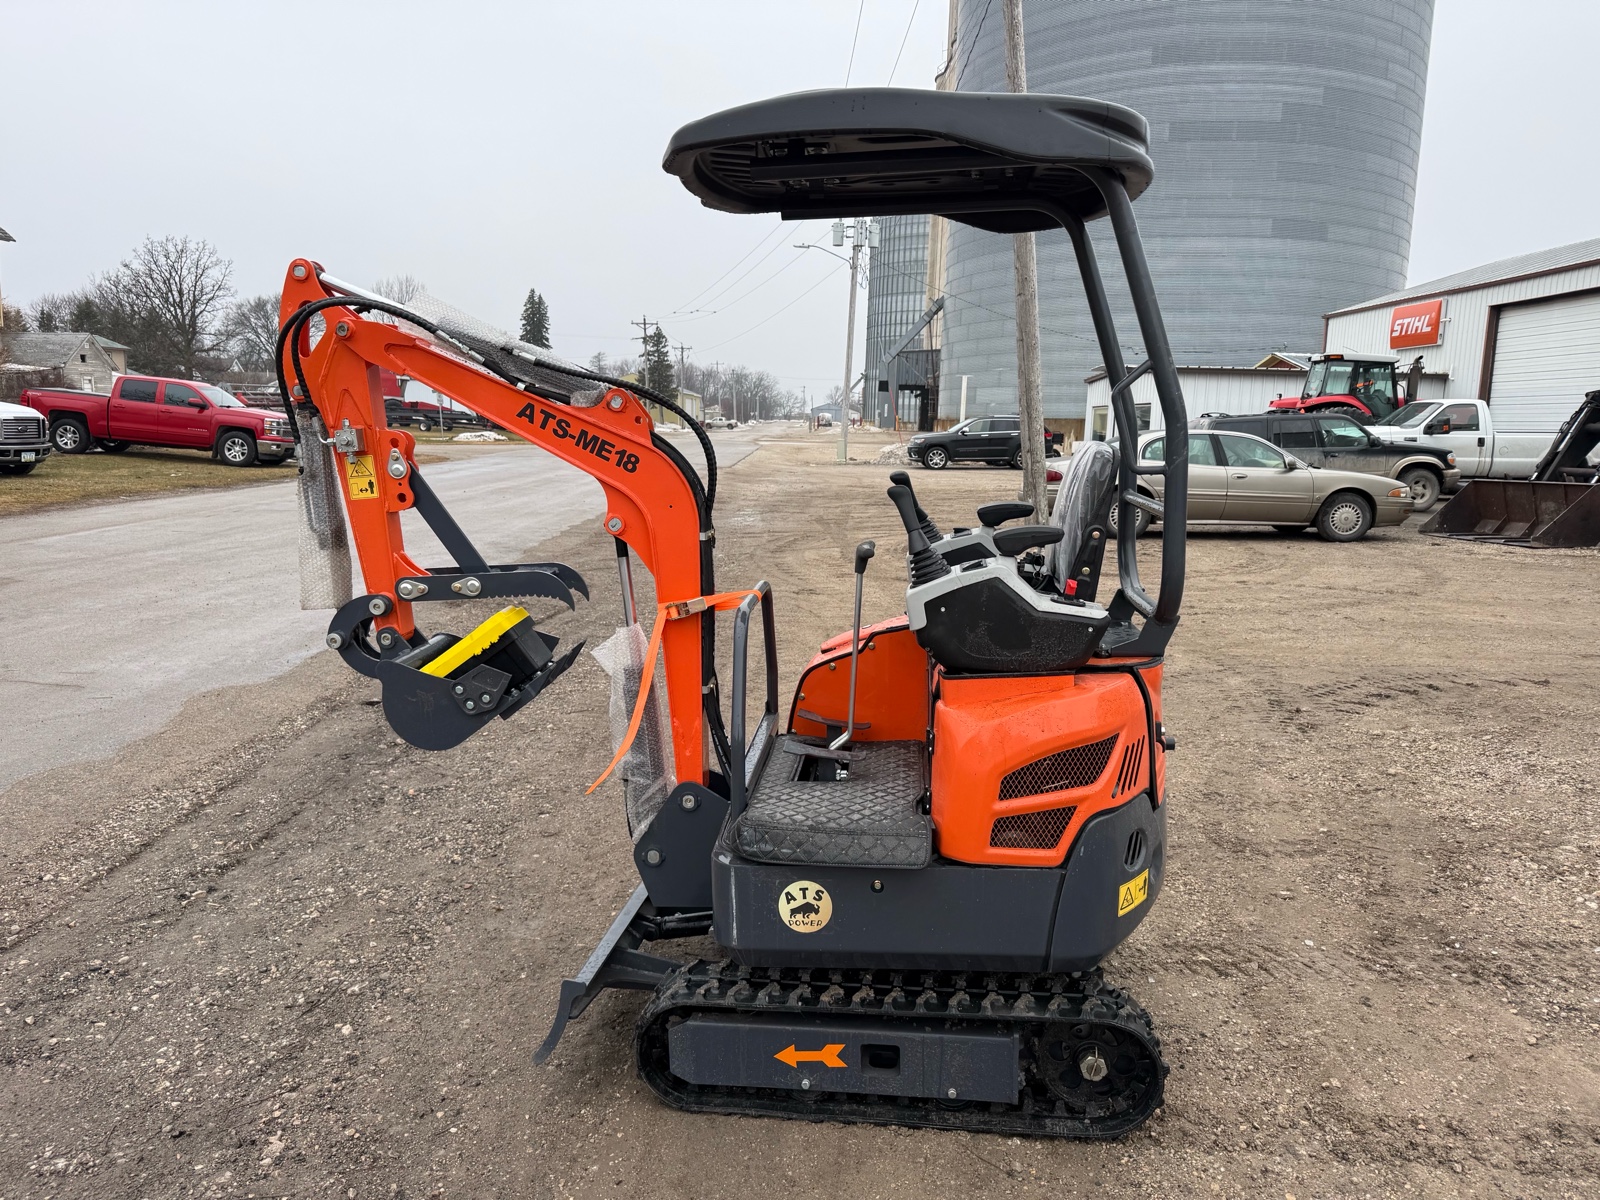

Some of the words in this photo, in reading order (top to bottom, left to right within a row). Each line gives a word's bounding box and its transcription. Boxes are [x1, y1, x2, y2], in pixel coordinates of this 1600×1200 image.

[1392, 315, 1431, 336] STIHL
[516, 402, 640, 474] ATS-ME18
[785, 887, 825, 905] ATS
